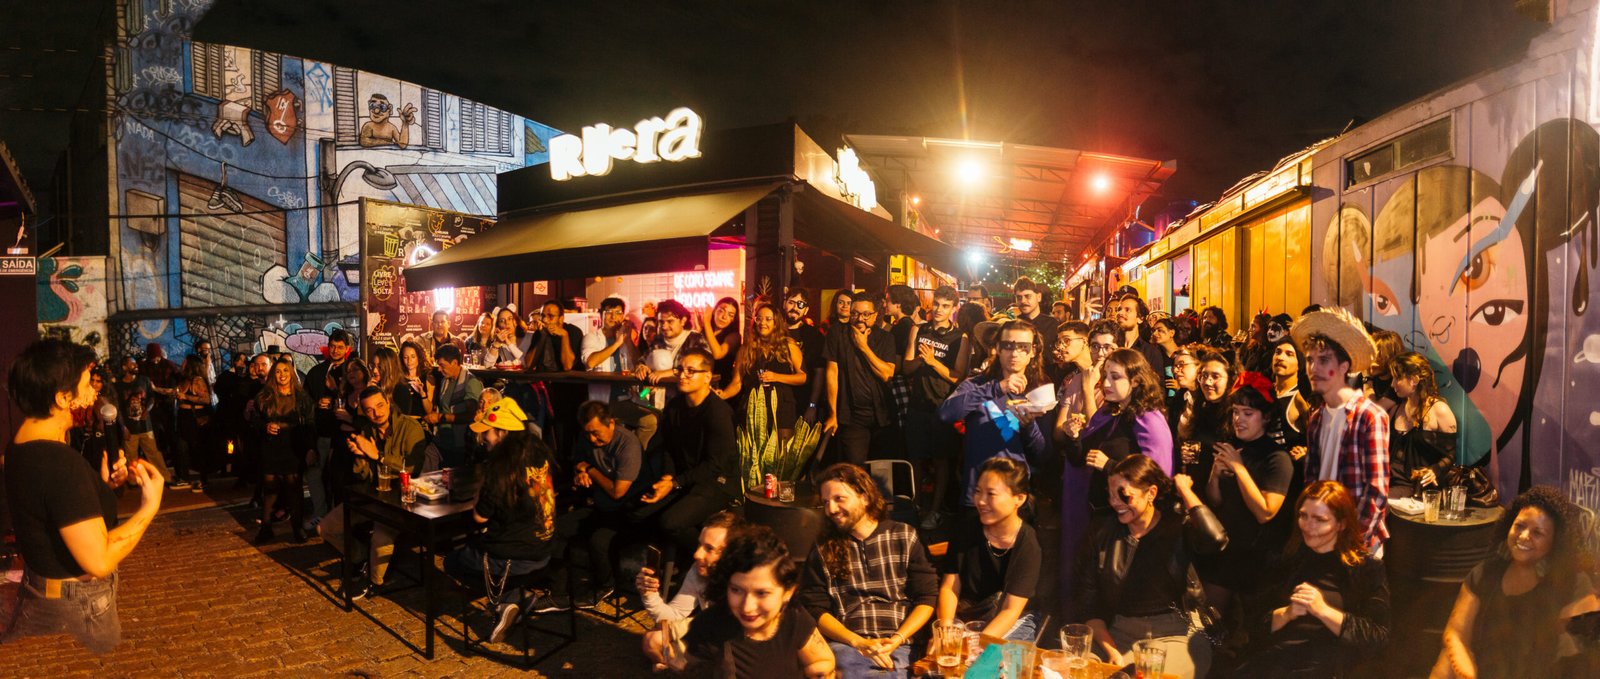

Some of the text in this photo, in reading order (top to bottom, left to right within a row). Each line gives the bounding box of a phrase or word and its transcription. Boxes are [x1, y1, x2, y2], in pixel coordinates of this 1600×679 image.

[126, 121, 155, 142] NADA
[2, 258, 33, 268] SAÍDA
[684, 272, 704, 288] COPO
[704, 271, 734, 287] SEMPRE
